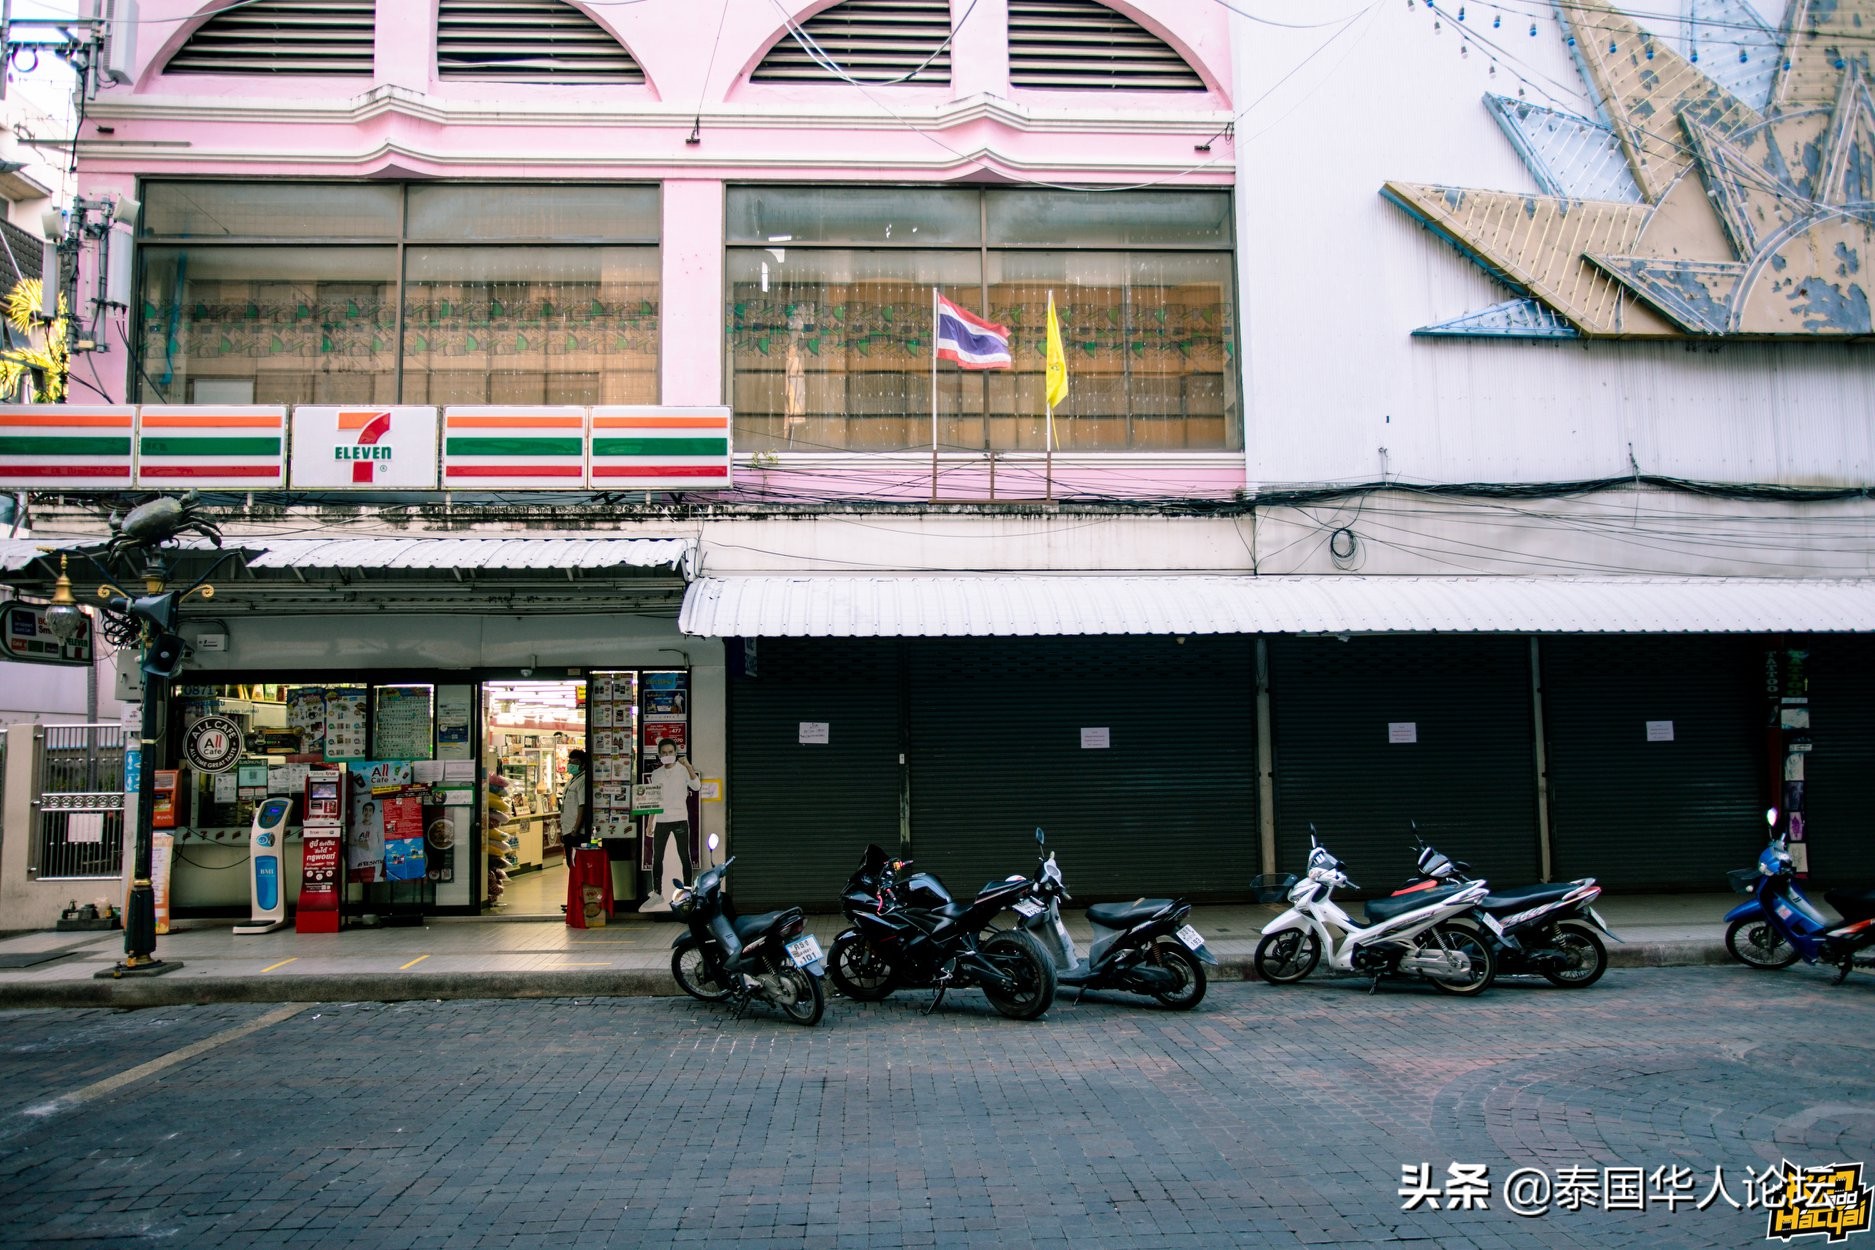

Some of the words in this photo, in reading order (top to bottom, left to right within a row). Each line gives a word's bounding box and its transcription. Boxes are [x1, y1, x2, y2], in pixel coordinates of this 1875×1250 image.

[192, 721, 212, 740] ALL
[204, 734, 222, 749] All
[207, 759, 227, 769] GREAT
[371, 763, 389, 777] All
[370, 776, 389, 784] Cafe
[802, 952, 816, 962] 101
